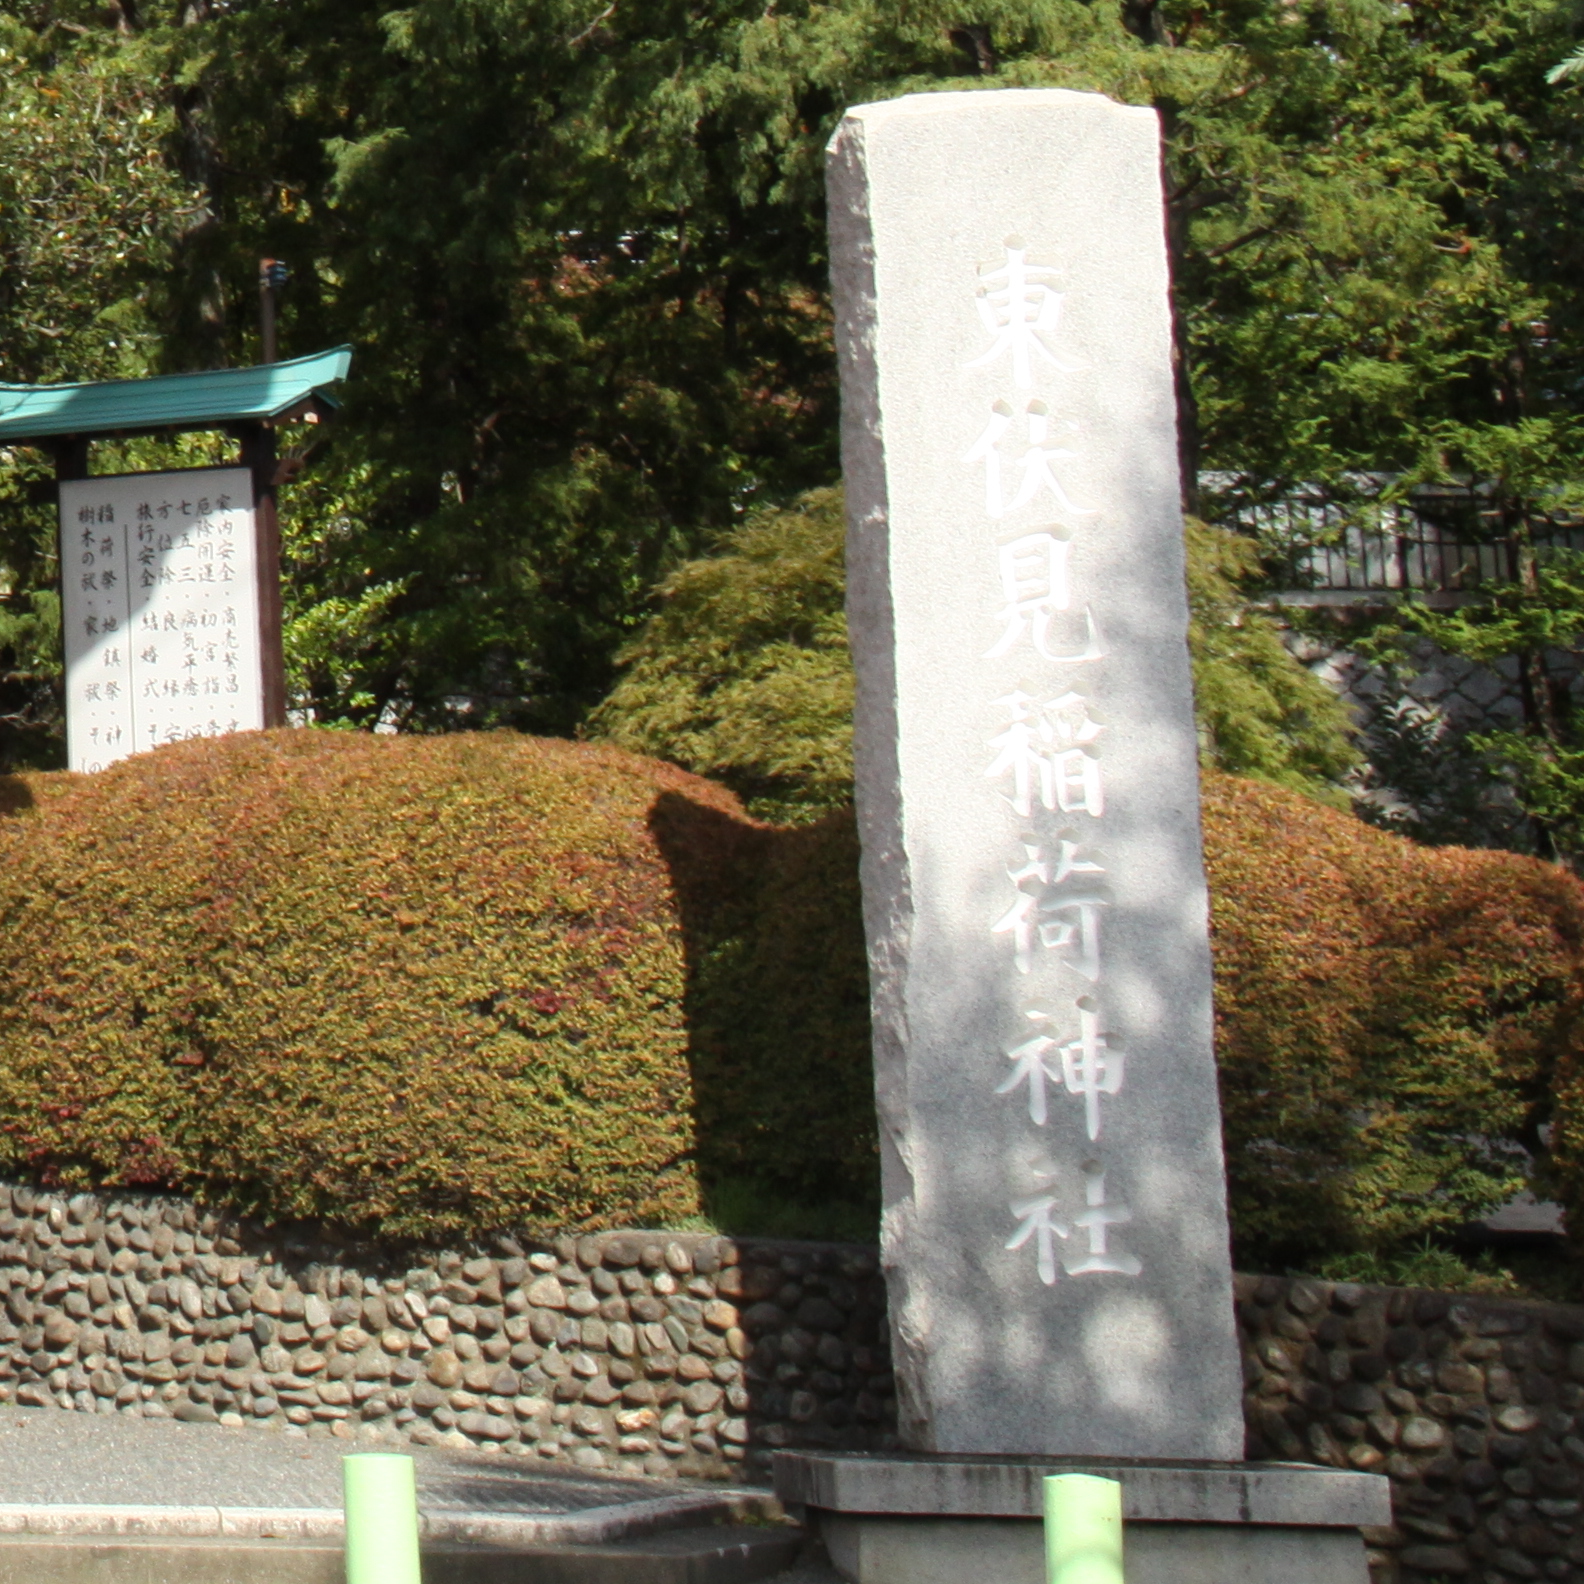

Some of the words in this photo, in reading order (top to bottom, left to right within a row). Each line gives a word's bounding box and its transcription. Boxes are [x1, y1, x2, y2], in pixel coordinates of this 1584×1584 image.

[962, 234, 1140, 1285] 東伏見稲荷神社
